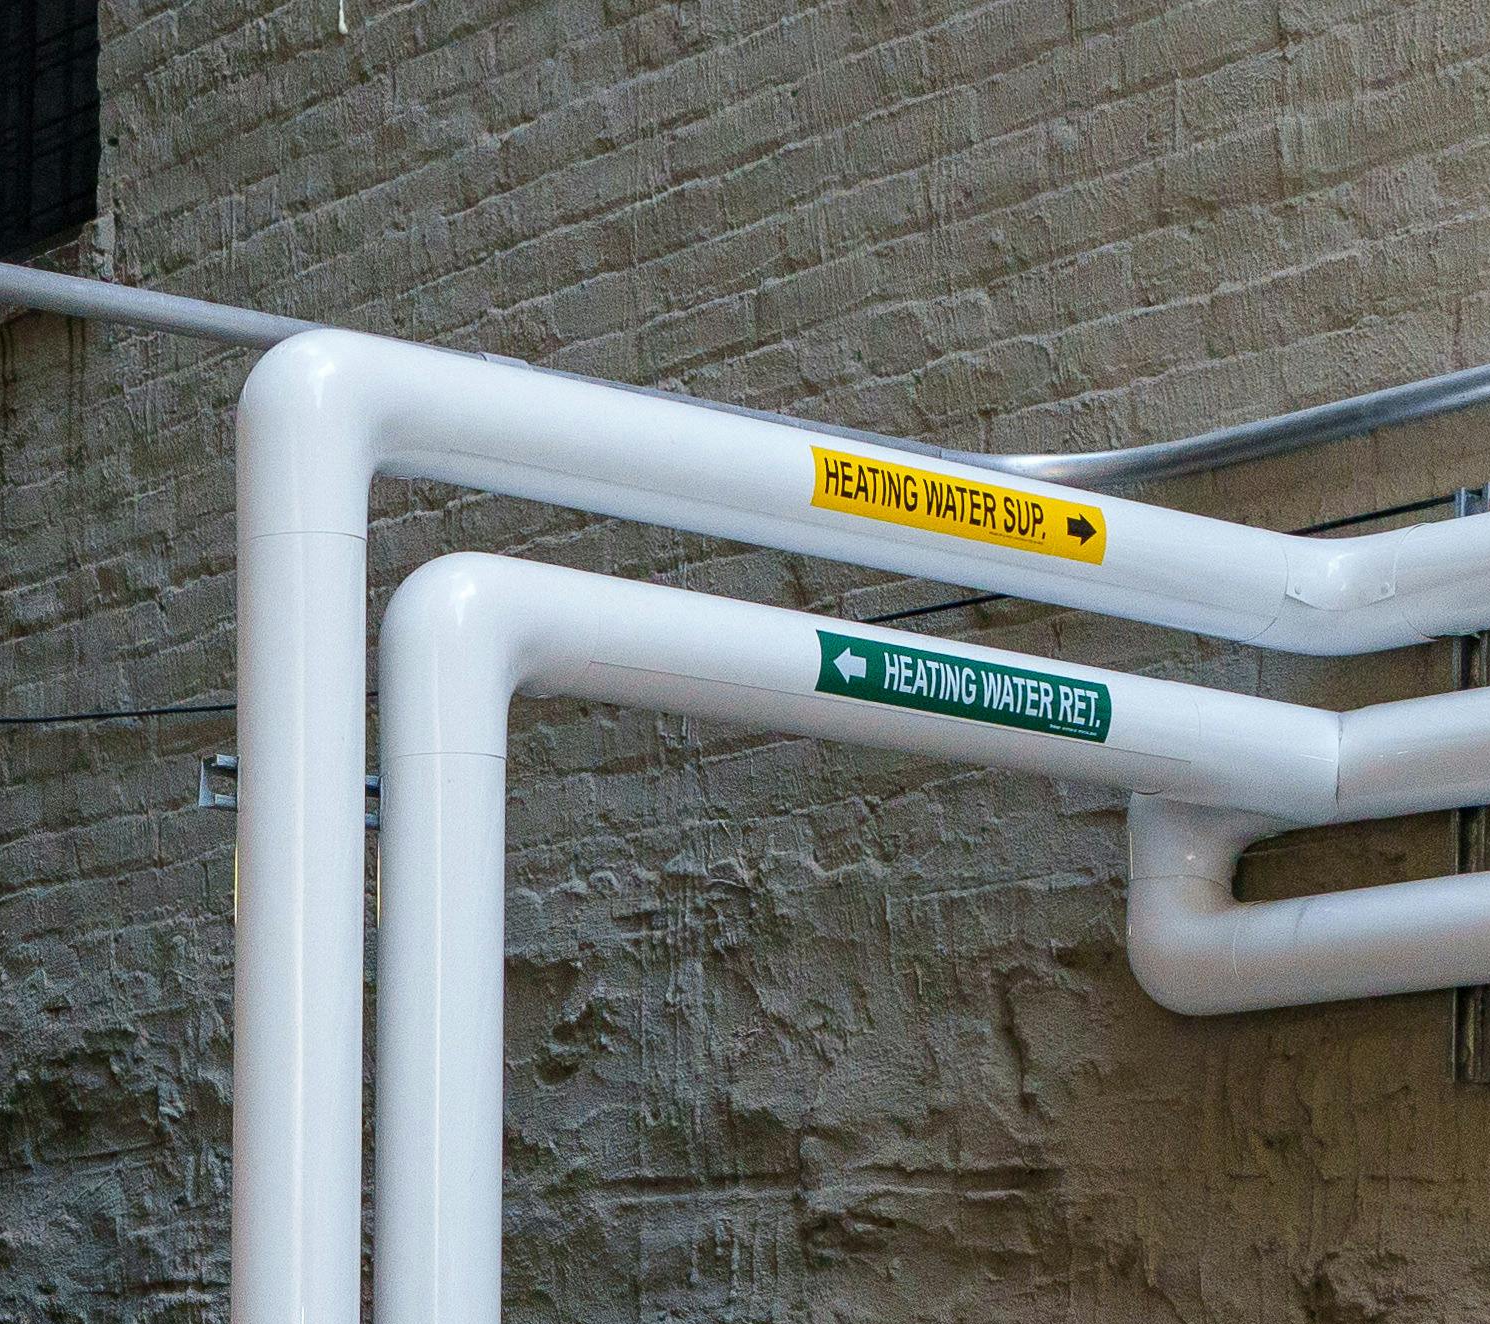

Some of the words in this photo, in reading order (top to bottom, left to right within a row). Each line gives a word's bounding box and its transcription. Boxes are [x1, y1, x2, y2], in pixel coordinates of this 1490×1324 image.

[823, 457, 919, 512] HEATING
[922, 478, 997, 530] WATER
[1003, 496, 1047, 539] SUP.
[883, 651, 977, 705] HEATING
[981, 670, 1053, 720] WATER
[1057, 684, 1101, 728] RET.
